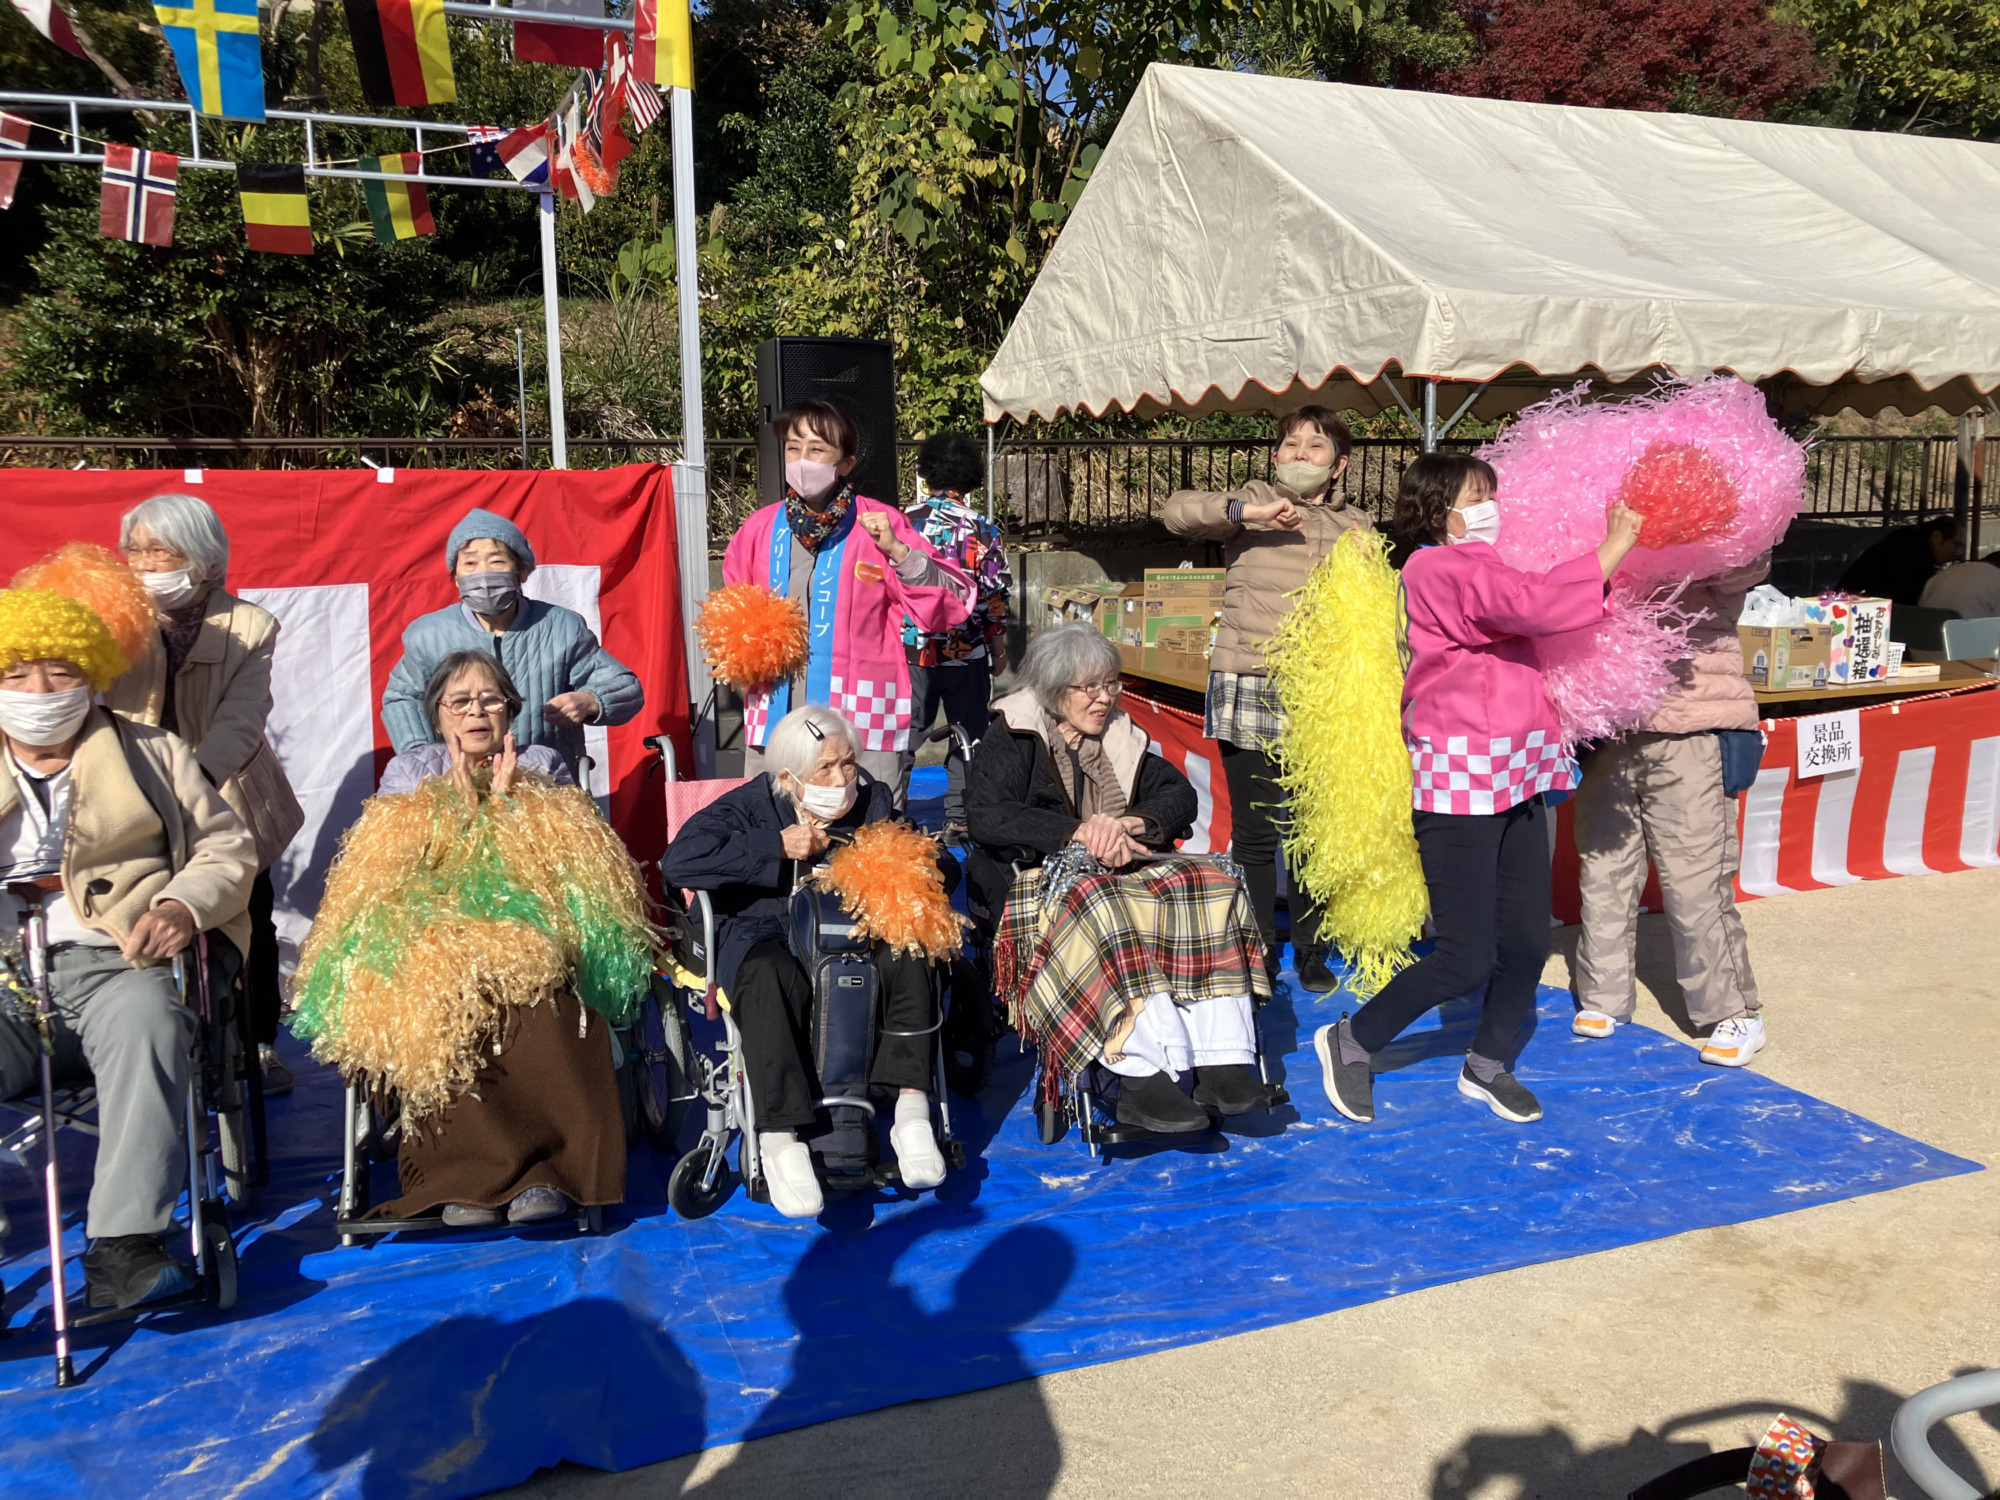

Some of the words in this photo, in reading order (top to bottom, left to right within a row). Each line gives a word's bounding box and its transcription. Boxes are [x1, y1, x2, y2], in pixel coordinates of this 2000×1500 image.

[1852, 613, 1874, 680] 抽選箱
[1871, 607, 1885, 660] おたのしみ
[1812, 720, 1844, 744] 景品
[1804, 740, 1852, 769] 交換所
